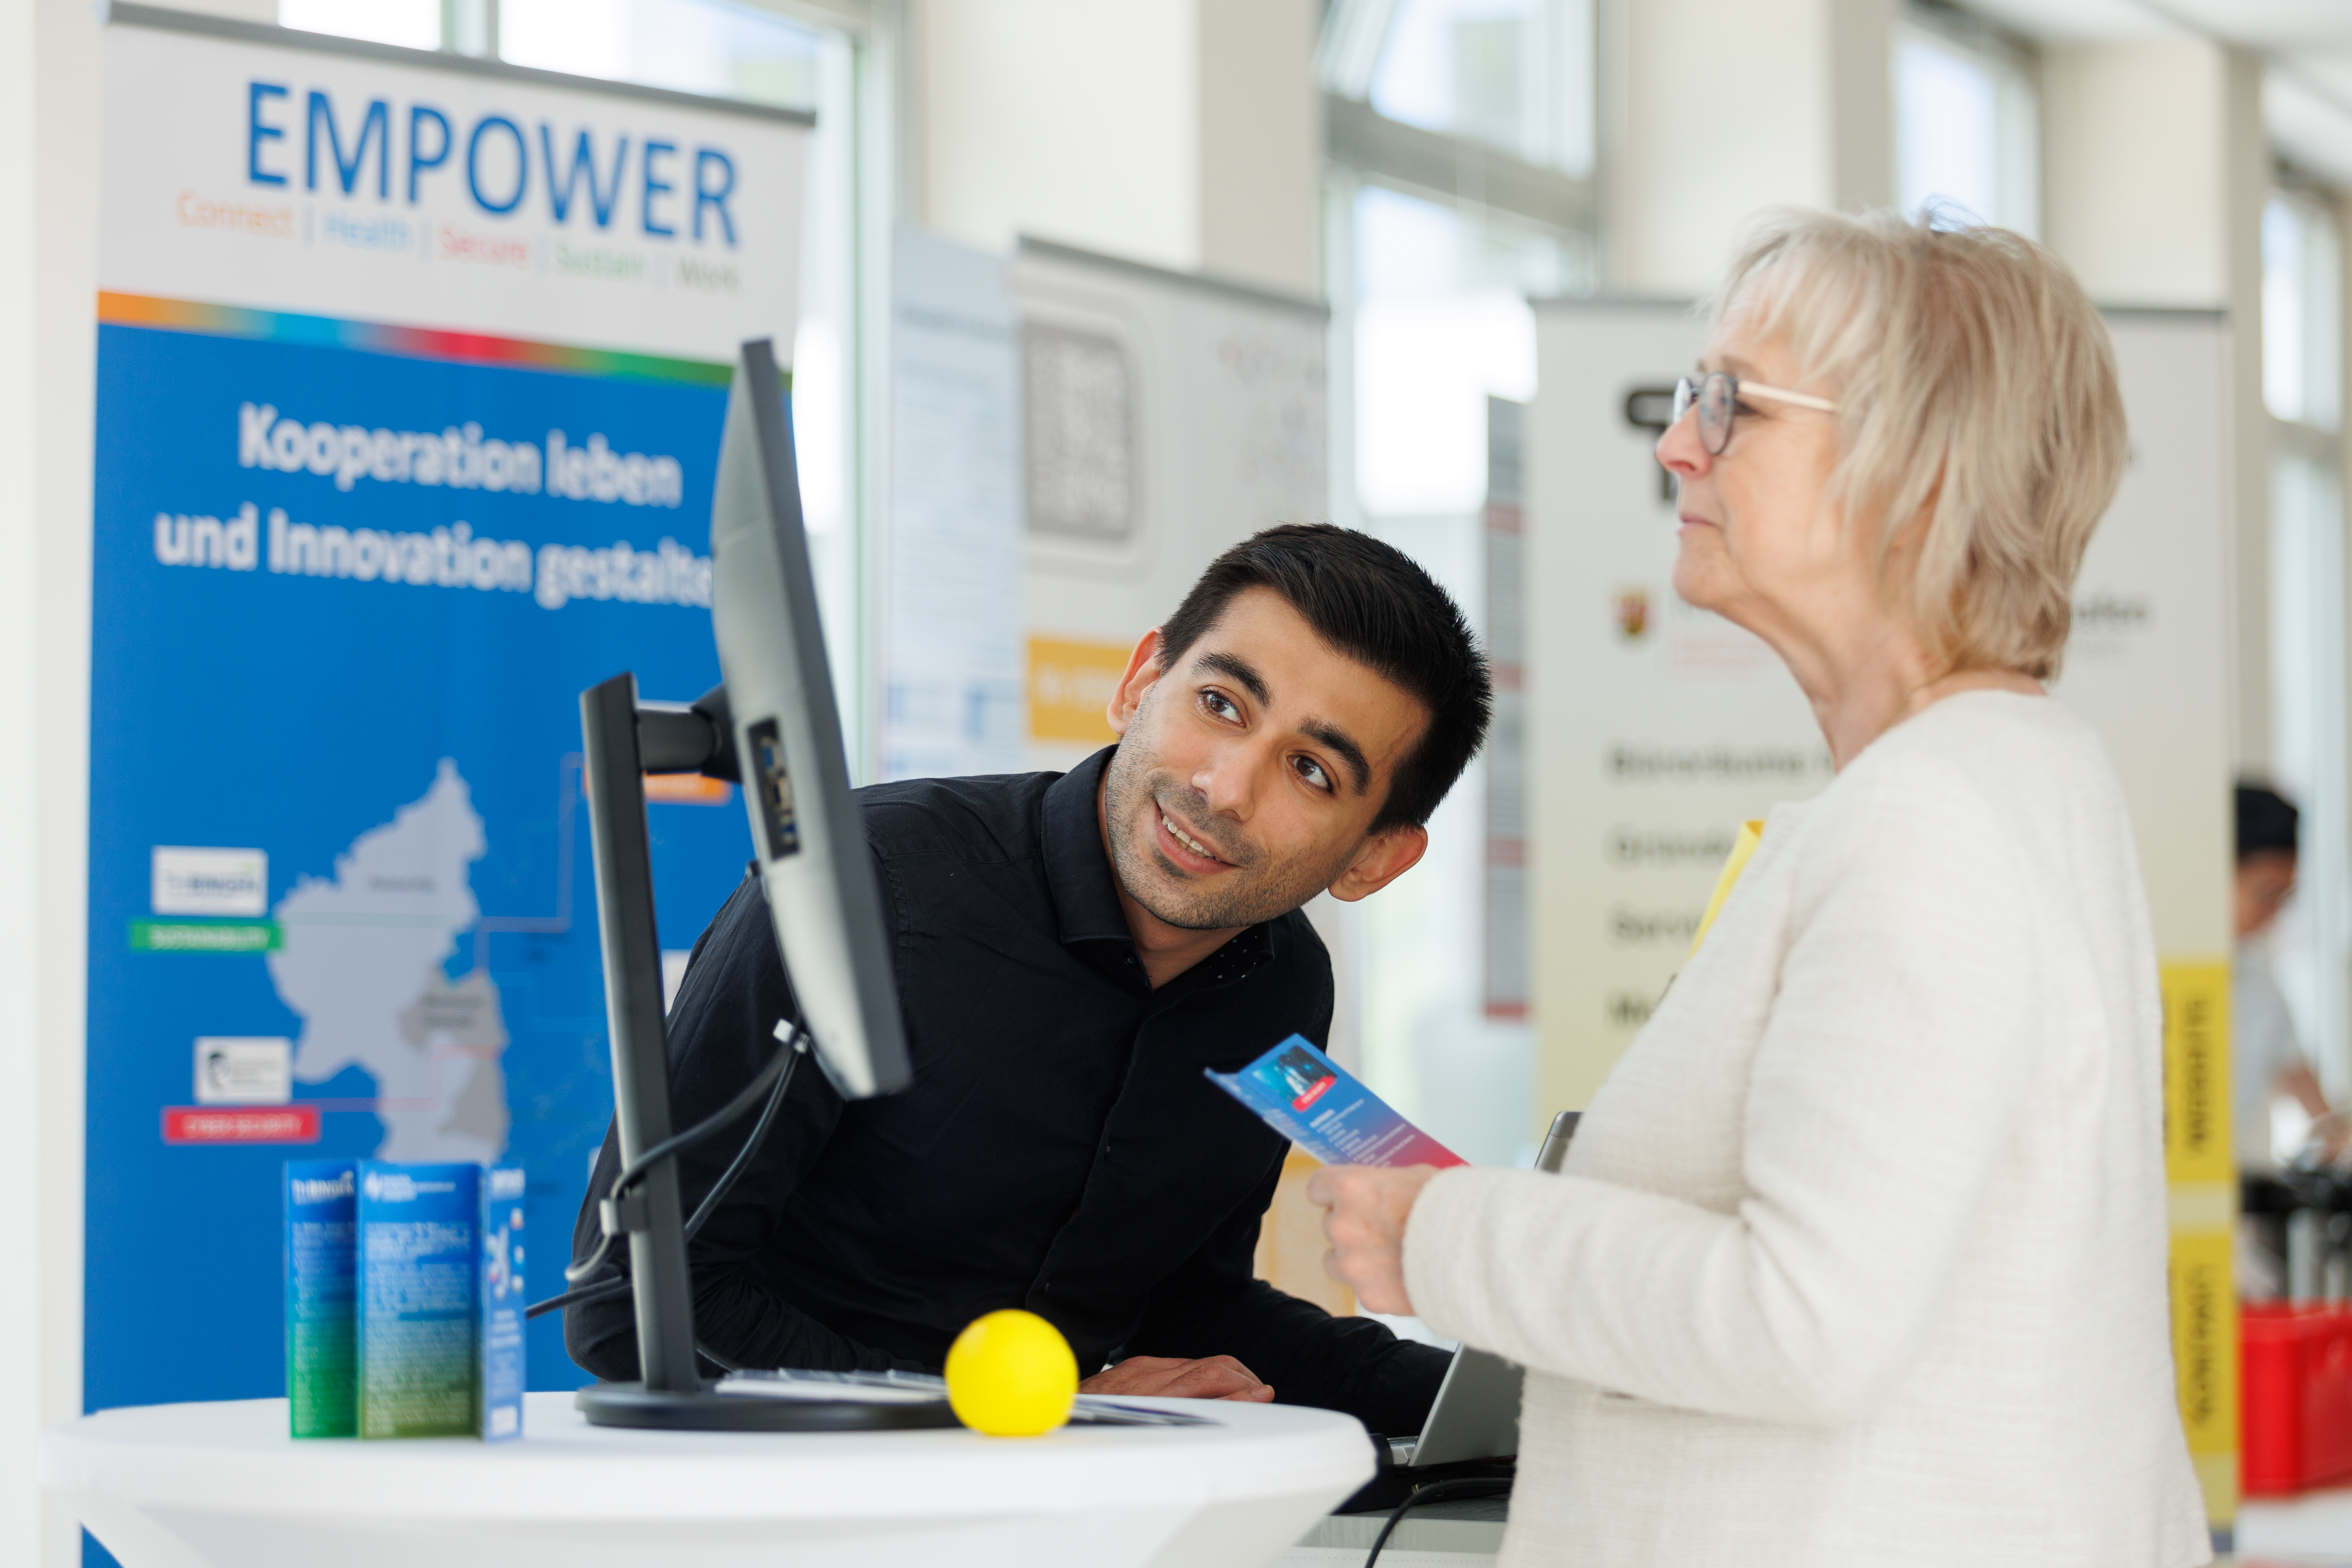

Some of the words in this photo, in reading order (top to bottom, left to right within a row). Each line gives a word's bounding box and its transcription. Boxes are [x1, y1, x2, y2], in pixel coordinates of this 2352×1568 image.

[246, 79, 741, 249] EMPOWER
[174, 190, 294, 241] Connect
[323, 208, 413, 252] Health
[440, 221, 529, 269] Secure
[239, 401, 542, 494] Kooperation
[546, 428, 683, 508] leben
[154, 502, 259, 571] und
[267, 507, 534, 593] Innovation
[535, 536, 715, 610] gestalte
